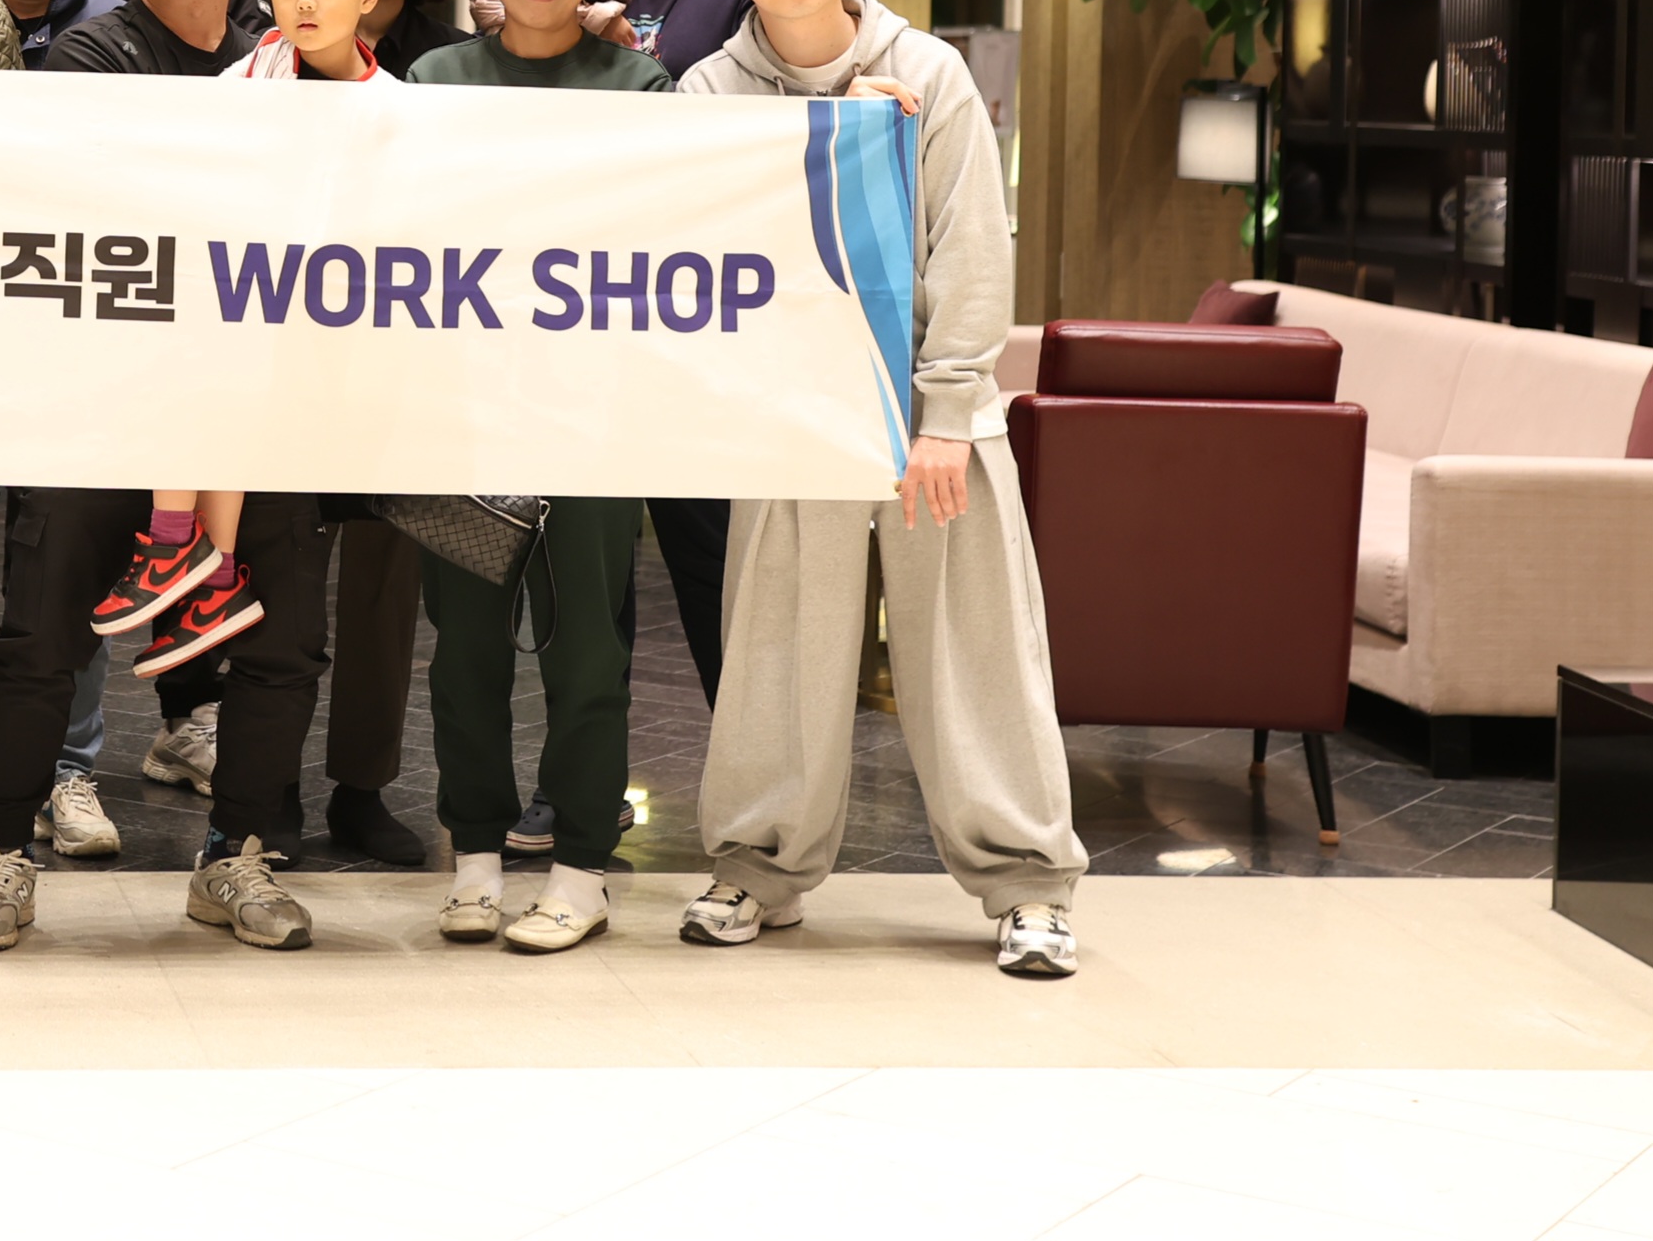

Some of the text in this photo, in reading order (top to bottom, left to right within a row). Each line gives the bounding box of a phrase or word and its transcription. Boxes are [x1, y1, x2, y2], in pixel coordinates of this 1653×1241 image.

[207, 241, 504, 329] WORK
[531, 247, 775, 333] SHOP
[217, 881, 238, 904] N
